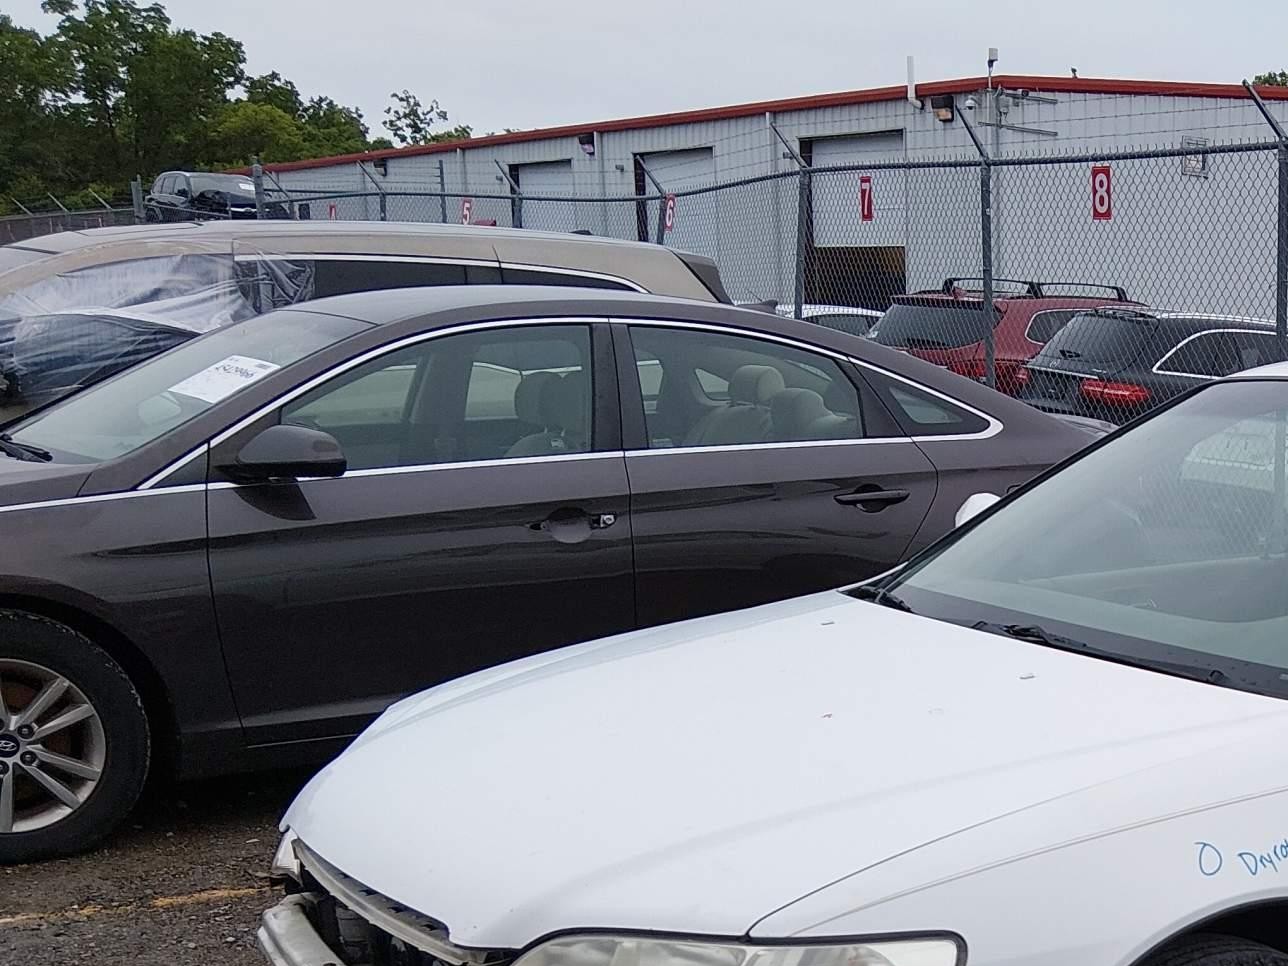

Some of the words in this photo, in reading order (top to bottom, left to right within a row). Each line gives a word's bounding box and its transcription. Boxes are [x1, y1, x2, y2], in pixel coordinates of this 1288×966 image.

[861, 182, 872, 215] 7
[1094, 172, 1109, 213] 8
[462, 201, 471, 225] 5
[666, 199, 674, 227] 6
